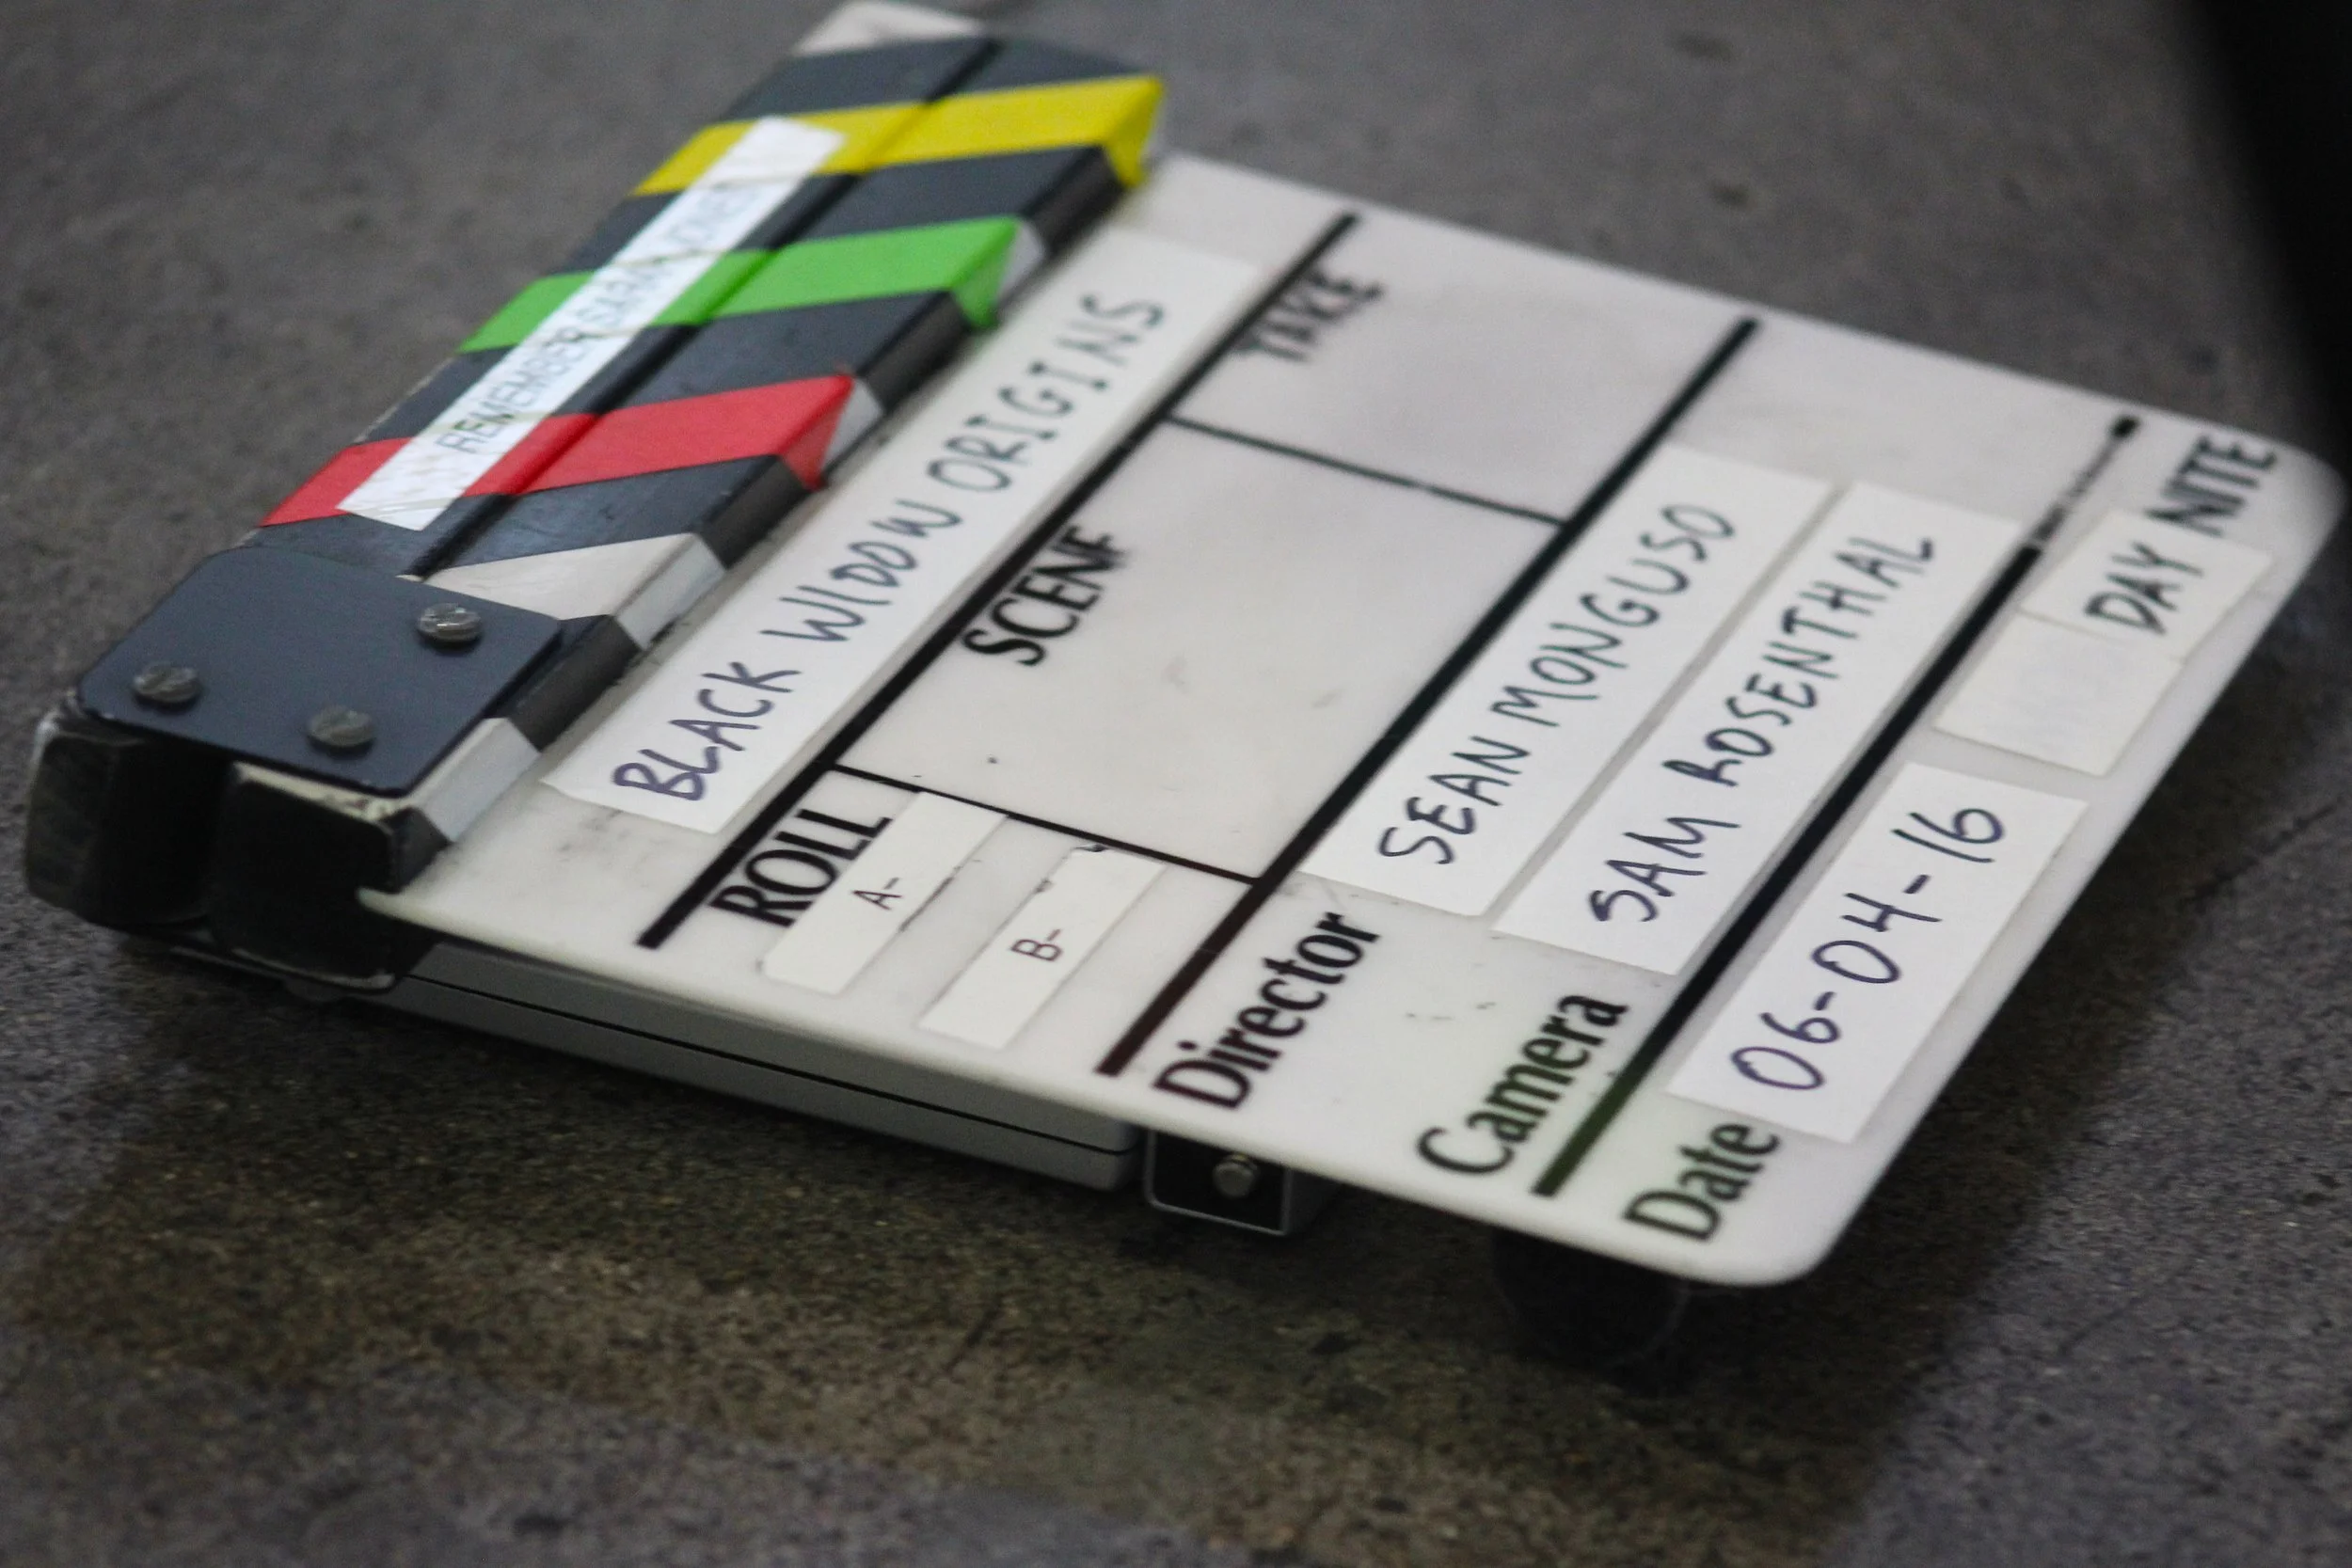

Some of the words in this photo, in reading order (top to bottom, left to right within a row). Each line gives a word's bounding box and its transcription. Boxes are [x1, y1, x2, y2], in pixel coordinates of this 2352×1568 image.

[612, 662, 802, 801] BLACK
[760, 499, 963, 642] WIDOW
[927, 293, 1165, 494] ORIGINS
[2146, 435, 2277, 536] NITE
[1661, 536, 1934, 787] ROSENTHAL
[2083, 541, 2205, 634] DAY
[1377, 736, 1530, 864] SEAN
[1489, 504, 1736, 727] MONGUSO
[710, 808, 894, 928] ROLL
[1588, 816, 1742, 924] SAM
[1728, 806, 2007, 1092] 06-04-16
[1152, 911, 1381, 1111] Director
[1417, 992, 1631, 1176] Camera
[1621, 1121, 1782, 1243] Date
